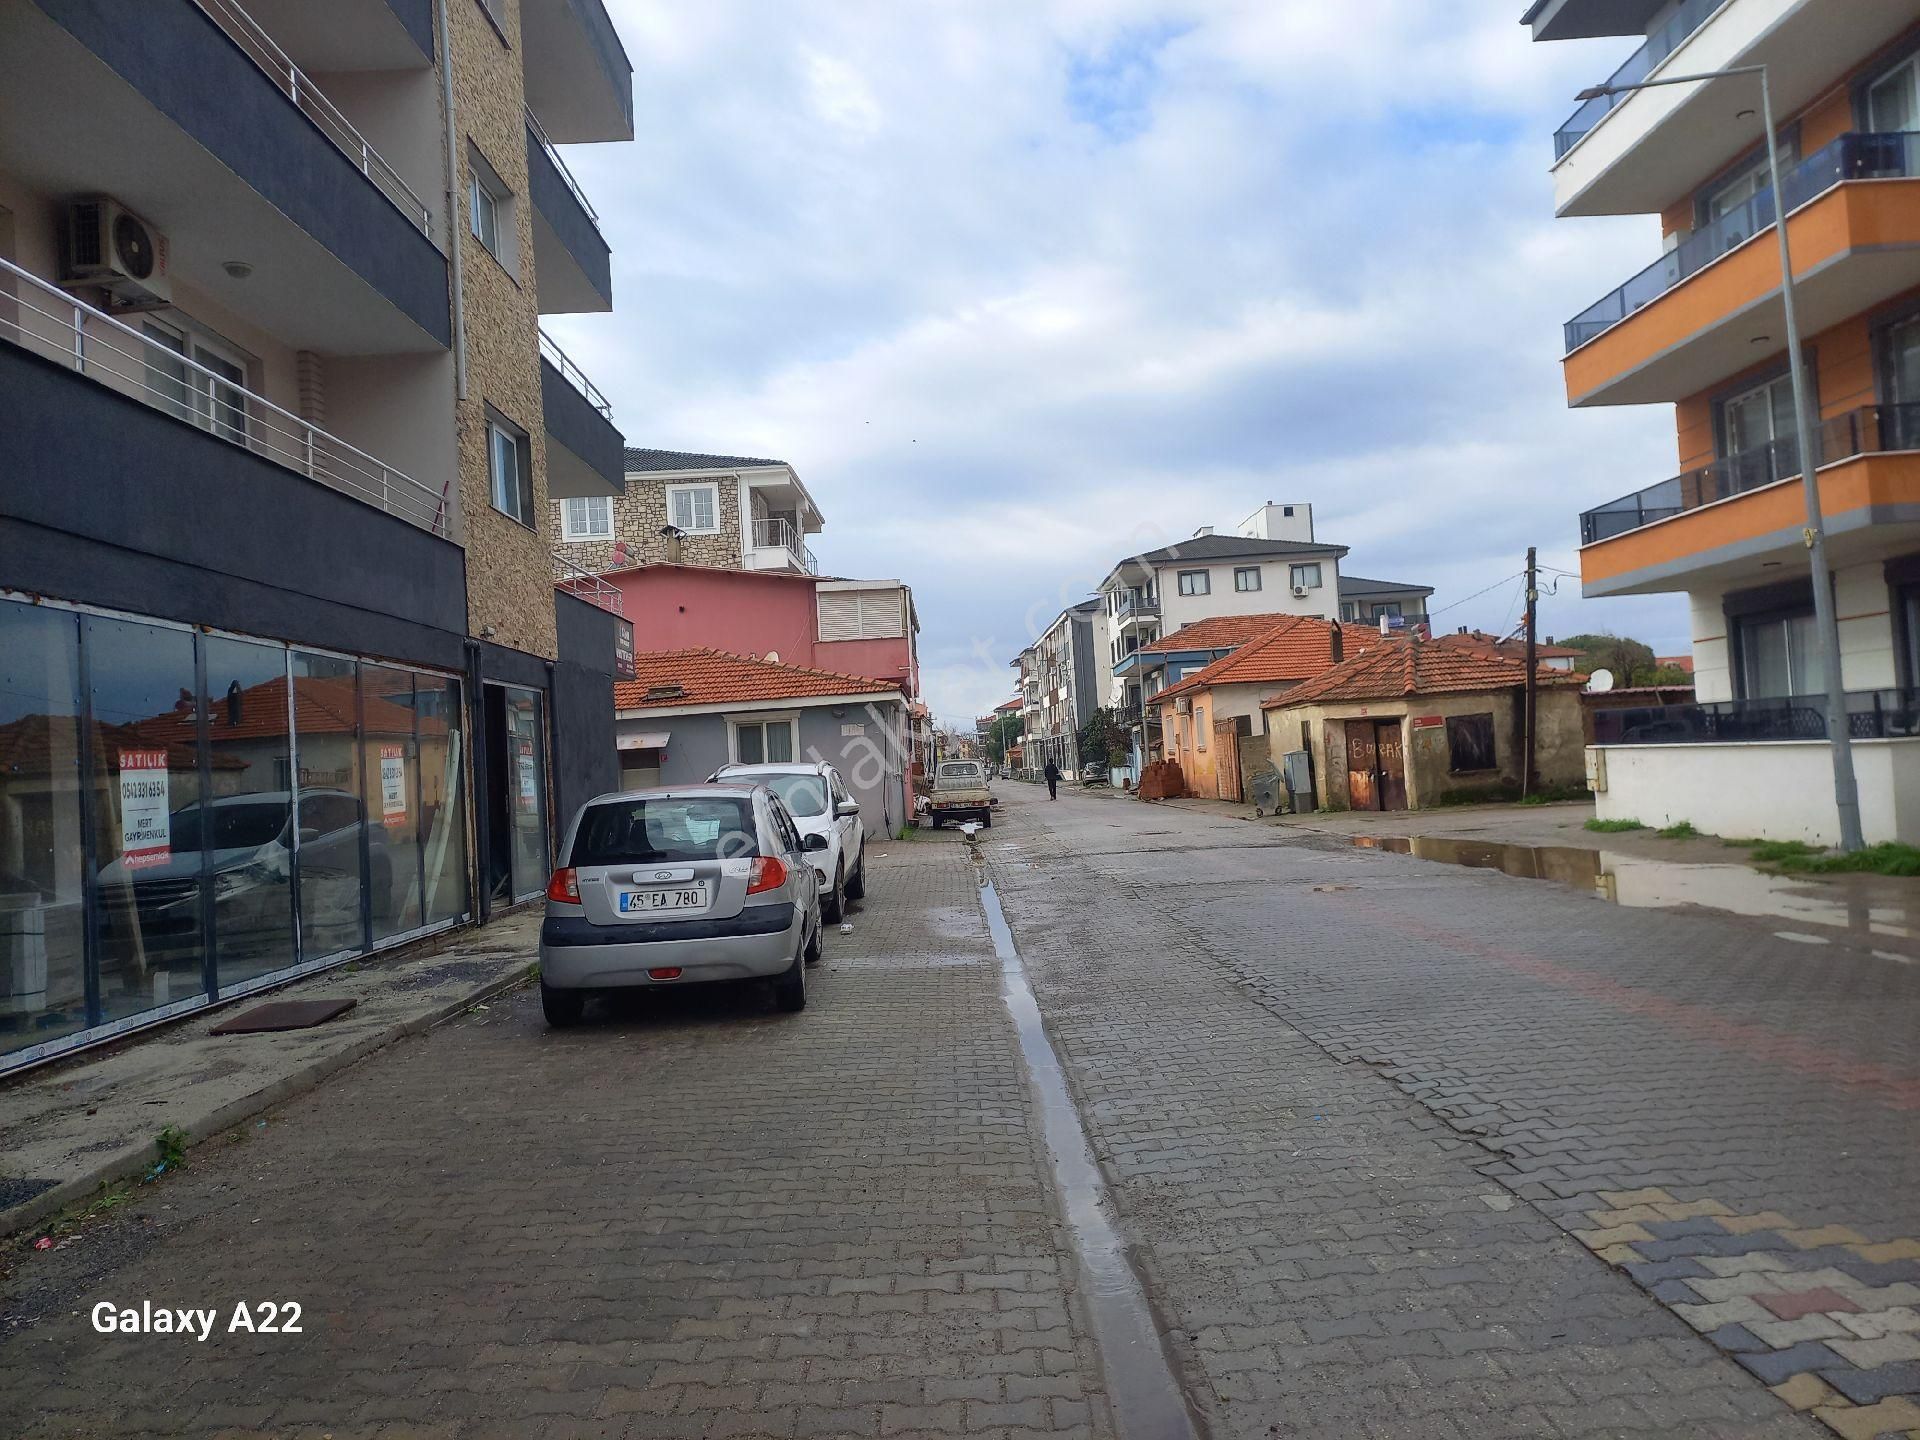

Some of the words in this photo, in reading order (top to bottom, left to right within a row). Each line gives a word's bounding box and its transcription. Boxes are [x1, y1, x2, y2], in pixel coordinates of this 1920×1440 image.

[119, 753, 166, 768] SATILIK
[629, 894, 644, 908] 45
[652, 893, 667, 907] EA
